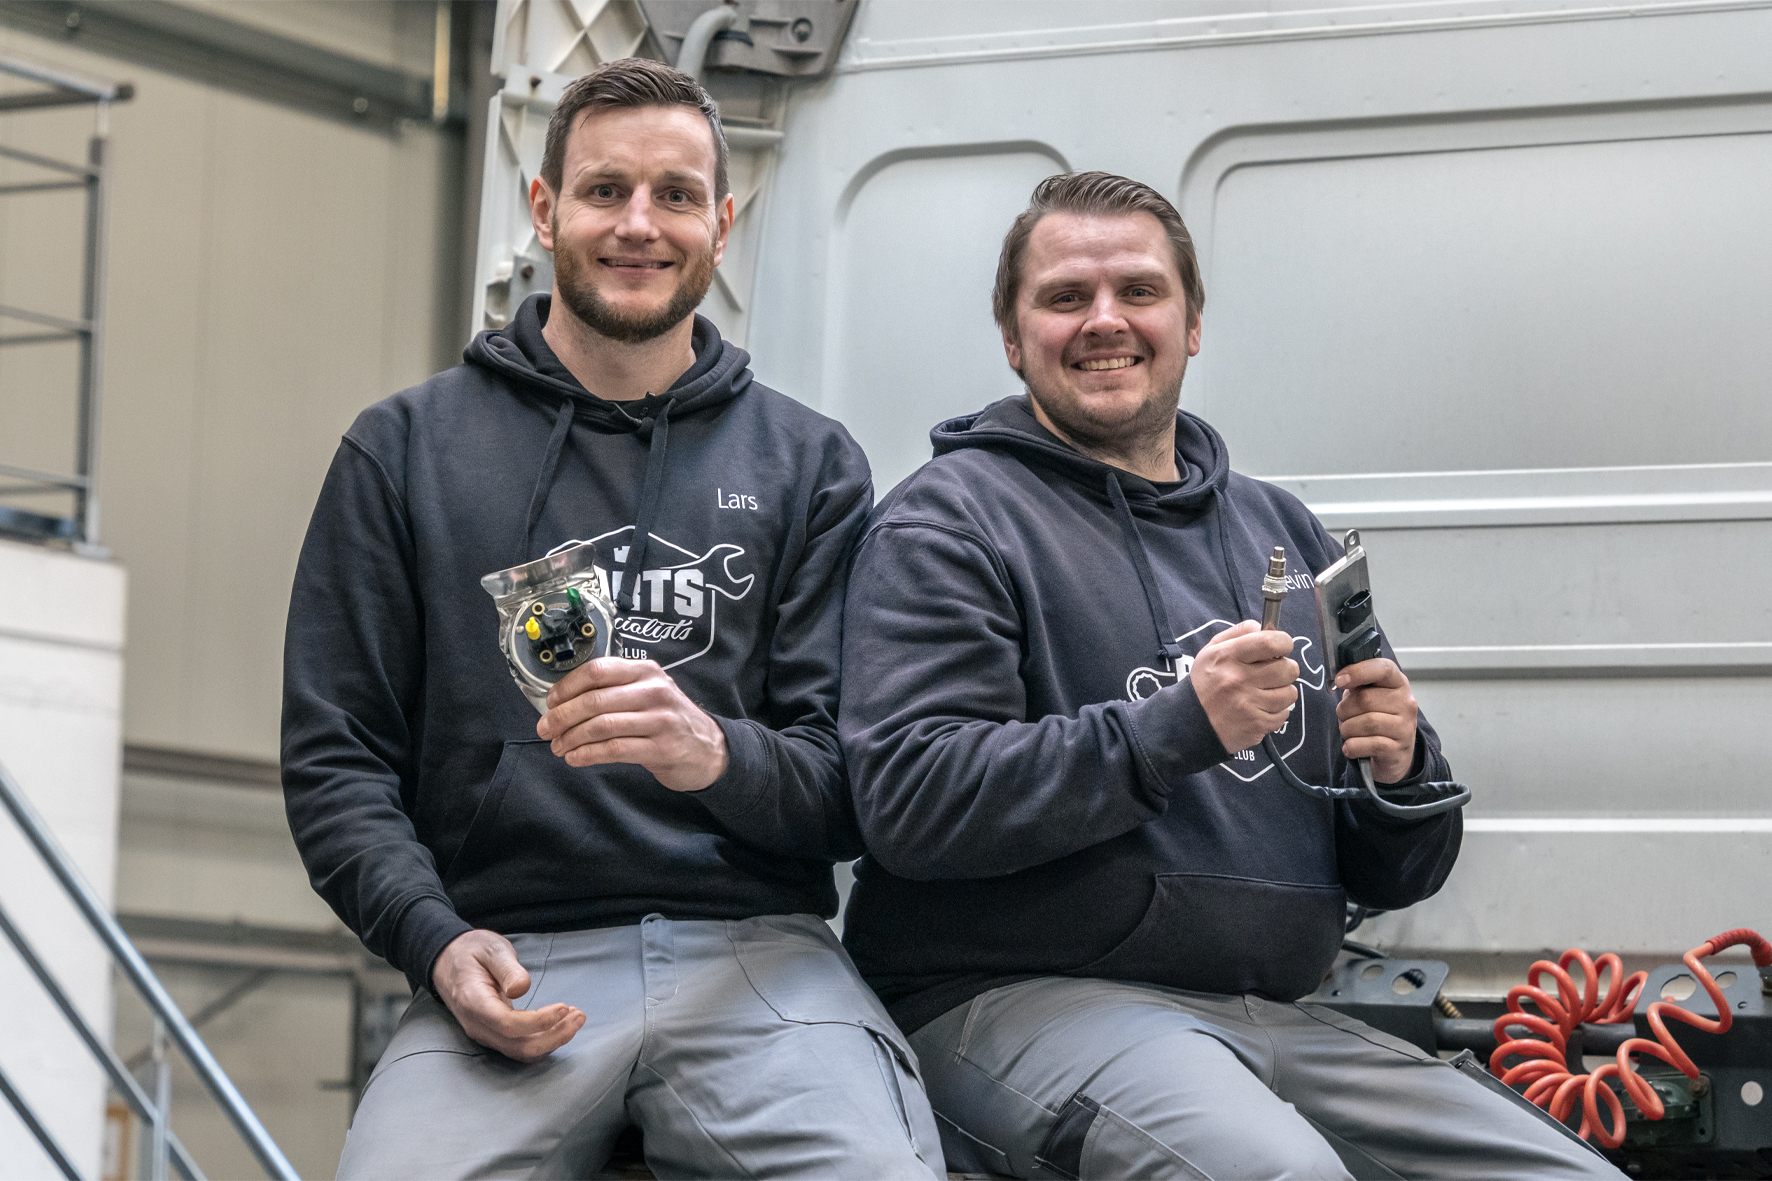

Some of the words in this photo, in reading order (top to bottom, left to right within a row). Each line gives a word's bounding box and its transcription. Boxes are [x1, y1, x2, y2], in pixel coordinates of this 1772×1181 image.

[717, 487, 758, 511] Lars
[1285, 569, 1315, 590] evin
[614, 617, 694, 641] cialists
[621, 647, 648, 660] LUB
[1234, 749, 1256, 762] LUB
